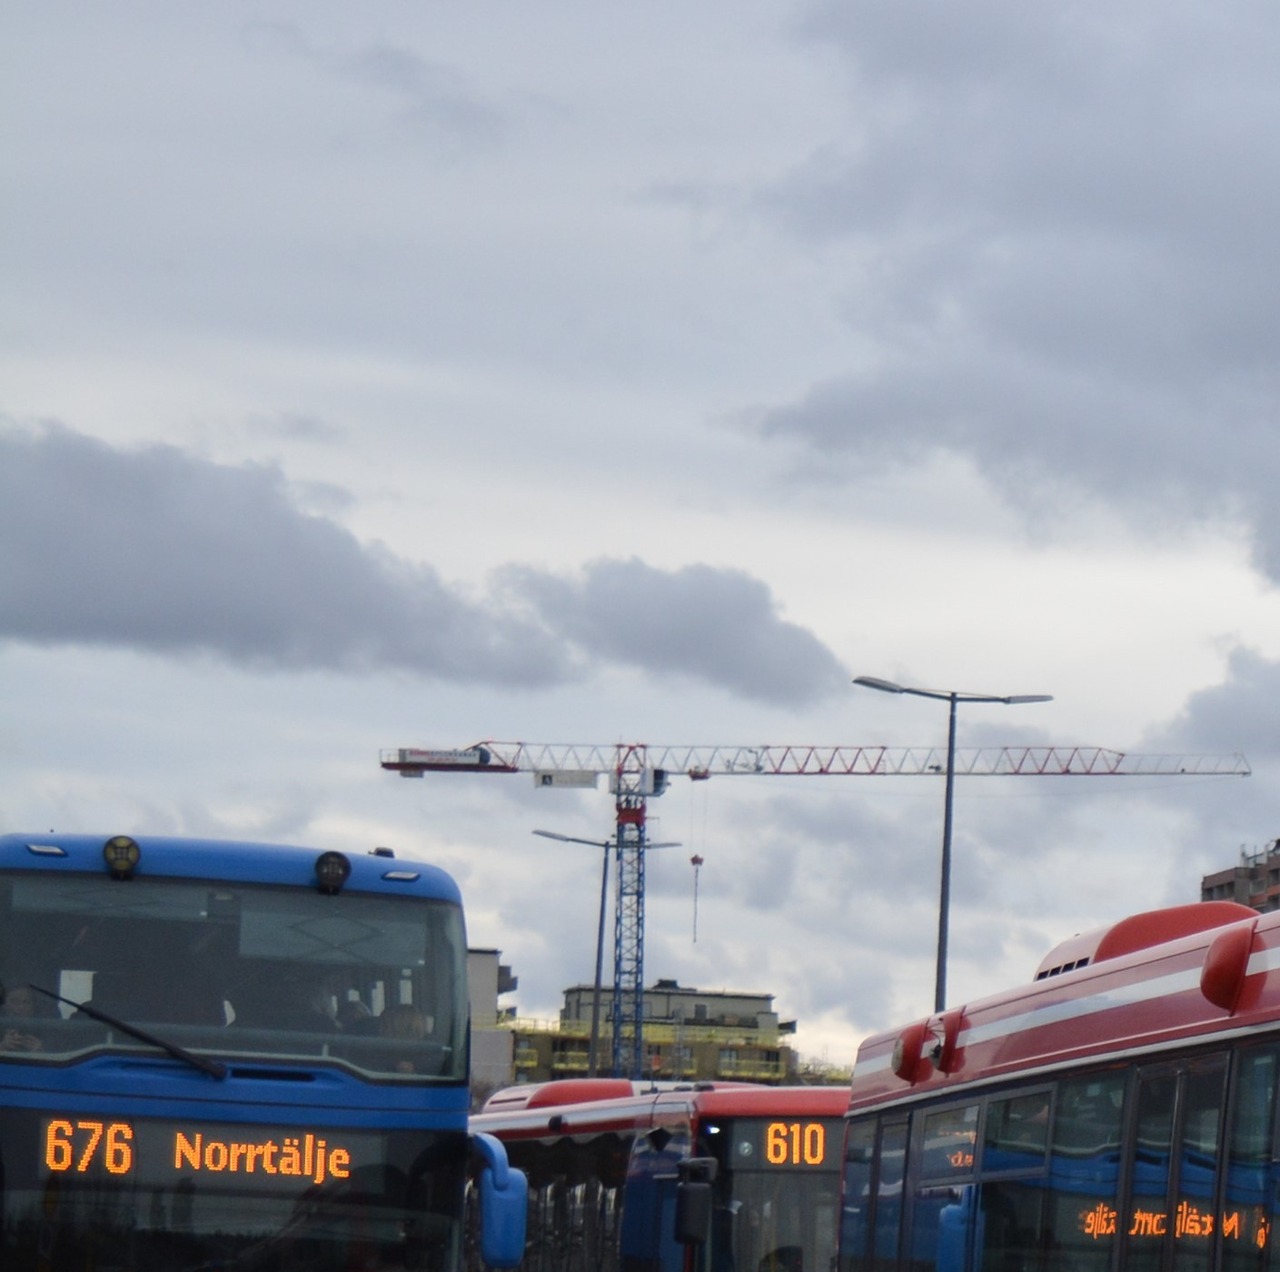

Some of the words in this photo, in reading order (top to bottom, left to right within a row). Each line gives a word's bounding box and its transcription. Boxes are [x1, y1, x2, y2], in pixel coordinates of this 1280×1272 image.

[45, 1119, 134, 1175] 676
[174, 1131, 350, 1185] Norrtälje
[766, 1122, 825, 1165] 610
